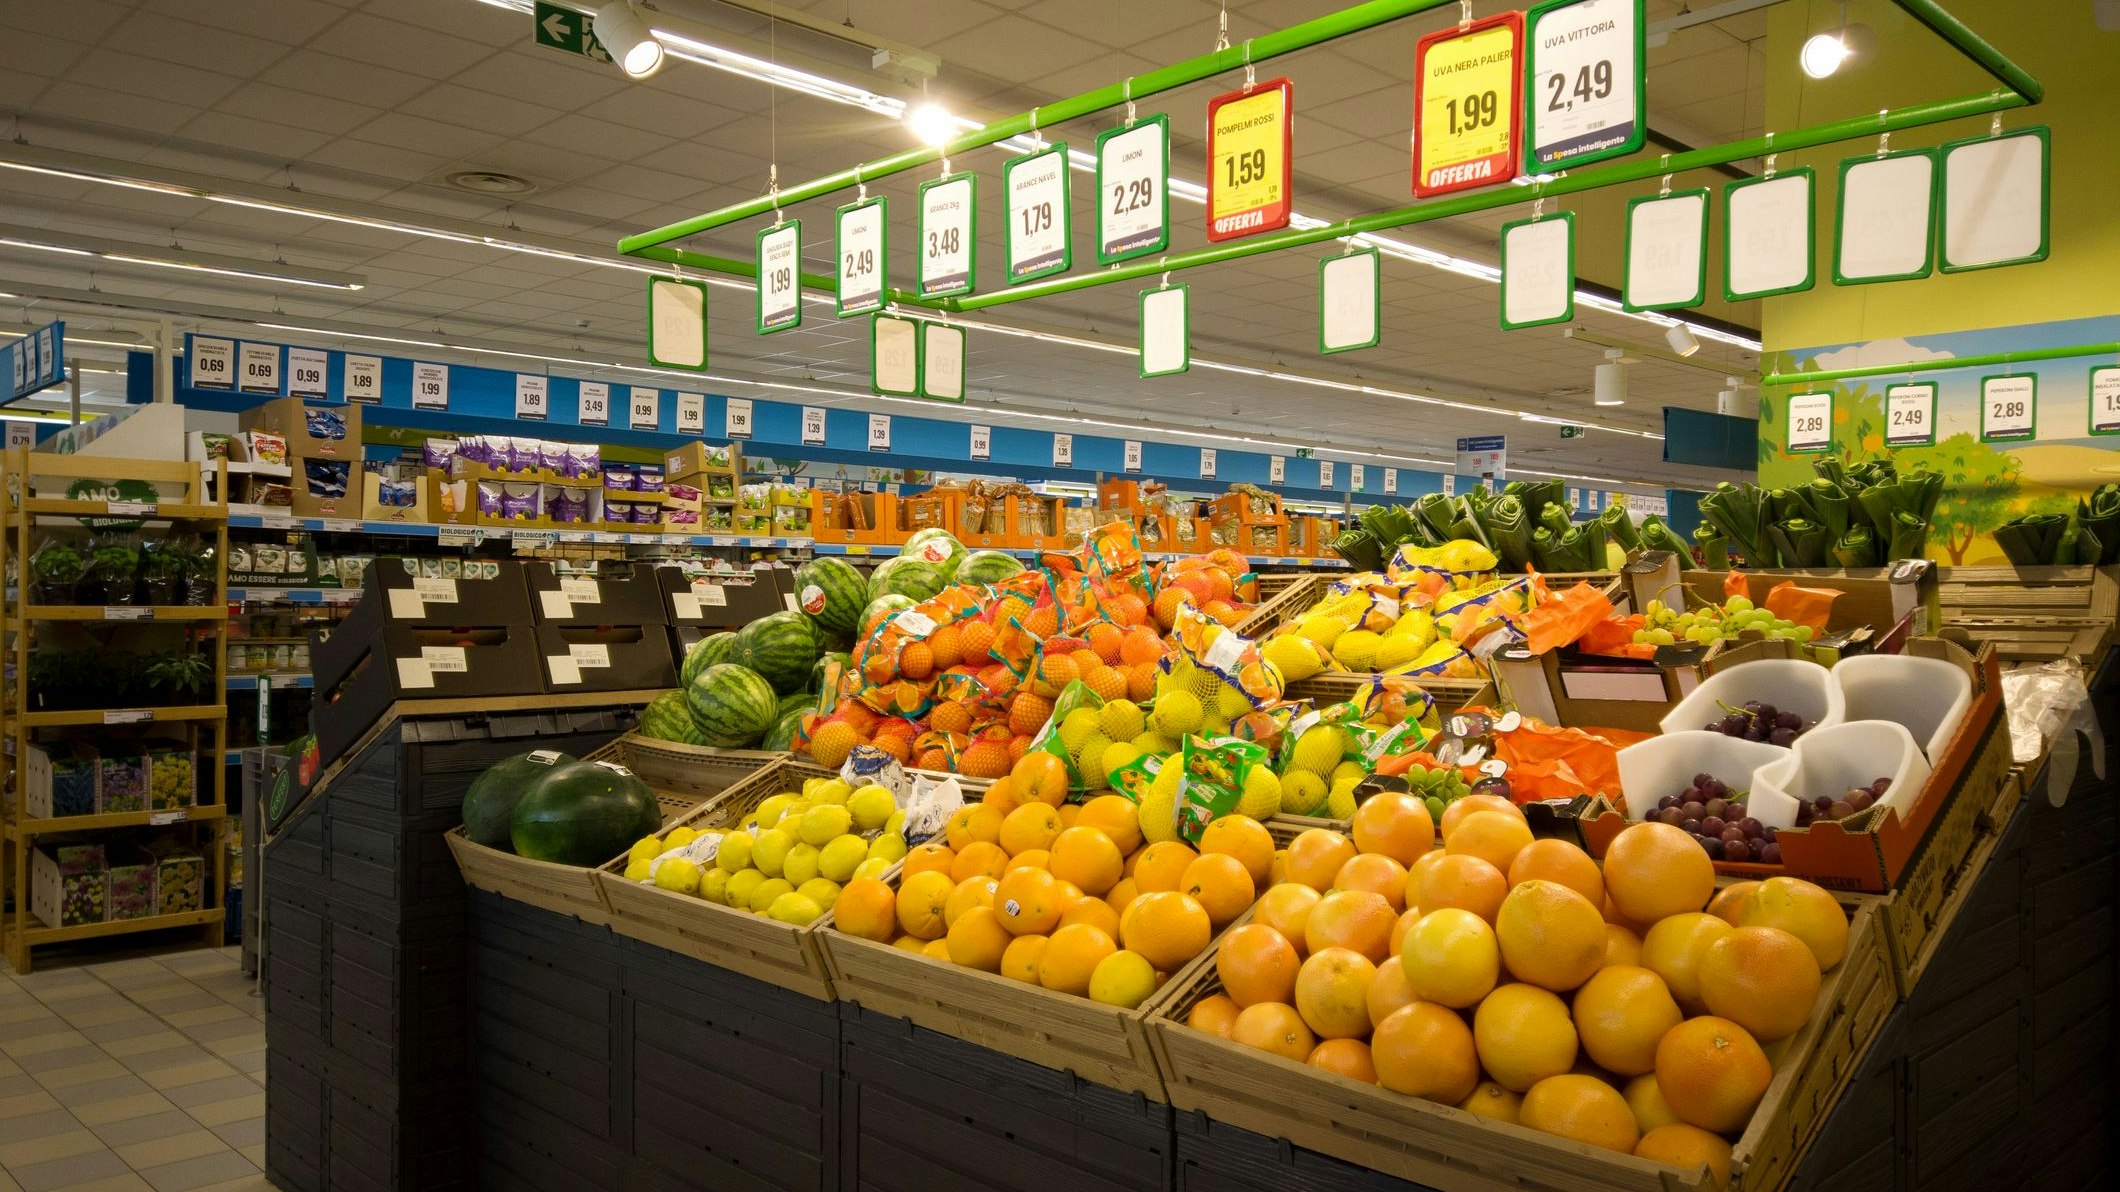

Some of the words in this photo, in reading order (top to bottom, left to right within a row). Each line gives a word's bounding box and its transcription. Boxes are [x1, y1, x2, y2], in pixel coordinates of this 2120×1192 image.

[1544, 36, 1565, 49] UVA
[1568, 20, 1615, 42] VITTORIA
[1433, 64, 1453, 77] UVA
[1455, 57, 1478, 72] NERA
[1547, 60, 1613, 113] 2,49
[1446, 90, 1497, 138] 1,99
[1217, 118, 1252, 136] POMPELMI
[1254, 113, 1275, 127] ROSSI
[1122, 149, 1143, 163] LIMONI
[1543, 154, 1553, 162] La
[1578, 136, 1625, 153] intelligente
[1226, 148, 1265, 190] 1,59
[1430, 160, 1491, 188] OFFERTA
[1016, 178, 1038, 191] ARANCE
[1038, 171, 1057, 184] NAVEL
[1114, 177, 1152, 216] 2,29
[930, 203, 949, 214] ARANCE
[949, 201, 960, 210] 2kg
[1022, 201, 1052, 237] 1,79
[1215, 210, 1263, 234] OFFERTA
[852, 225, 867, 235] LIMONI
[929, 227, 960, 260] 3,48
[846, 249, 873, 280] 2,49
[770, 267, 791, 296] 1,99
[200, 358, 224, 372] 0,69
[248, 363, 272, 378] 0,69
[297, 368, 320, 383] 0,99
[352, 374, 372, 388] 1,89
[421, 382, 440, 395] 1,99
[523, 393, 540, 406] 1,89
[584, 399, 603, 412] 3,49
[635, 404, 652, 416] 0,99
[684, 410, 698, 422] 1,99
[1993, 401, 2024, 419] 2,89
[732, 414, 745, 426] 1,99
[1796, 417, 1823, 433] 2,89
[1893, 410, 1922, 426] 2,49
[808, 423, 820, 434] 1,39
[974, 440, 986, 450] 0,99
[77, 487, 120, 501] AMO
[514, 531, 542, 539] BIOLOGICO
[227, 574, 248, 583] AMO
[248, 576, 277, 584] ESSERE
